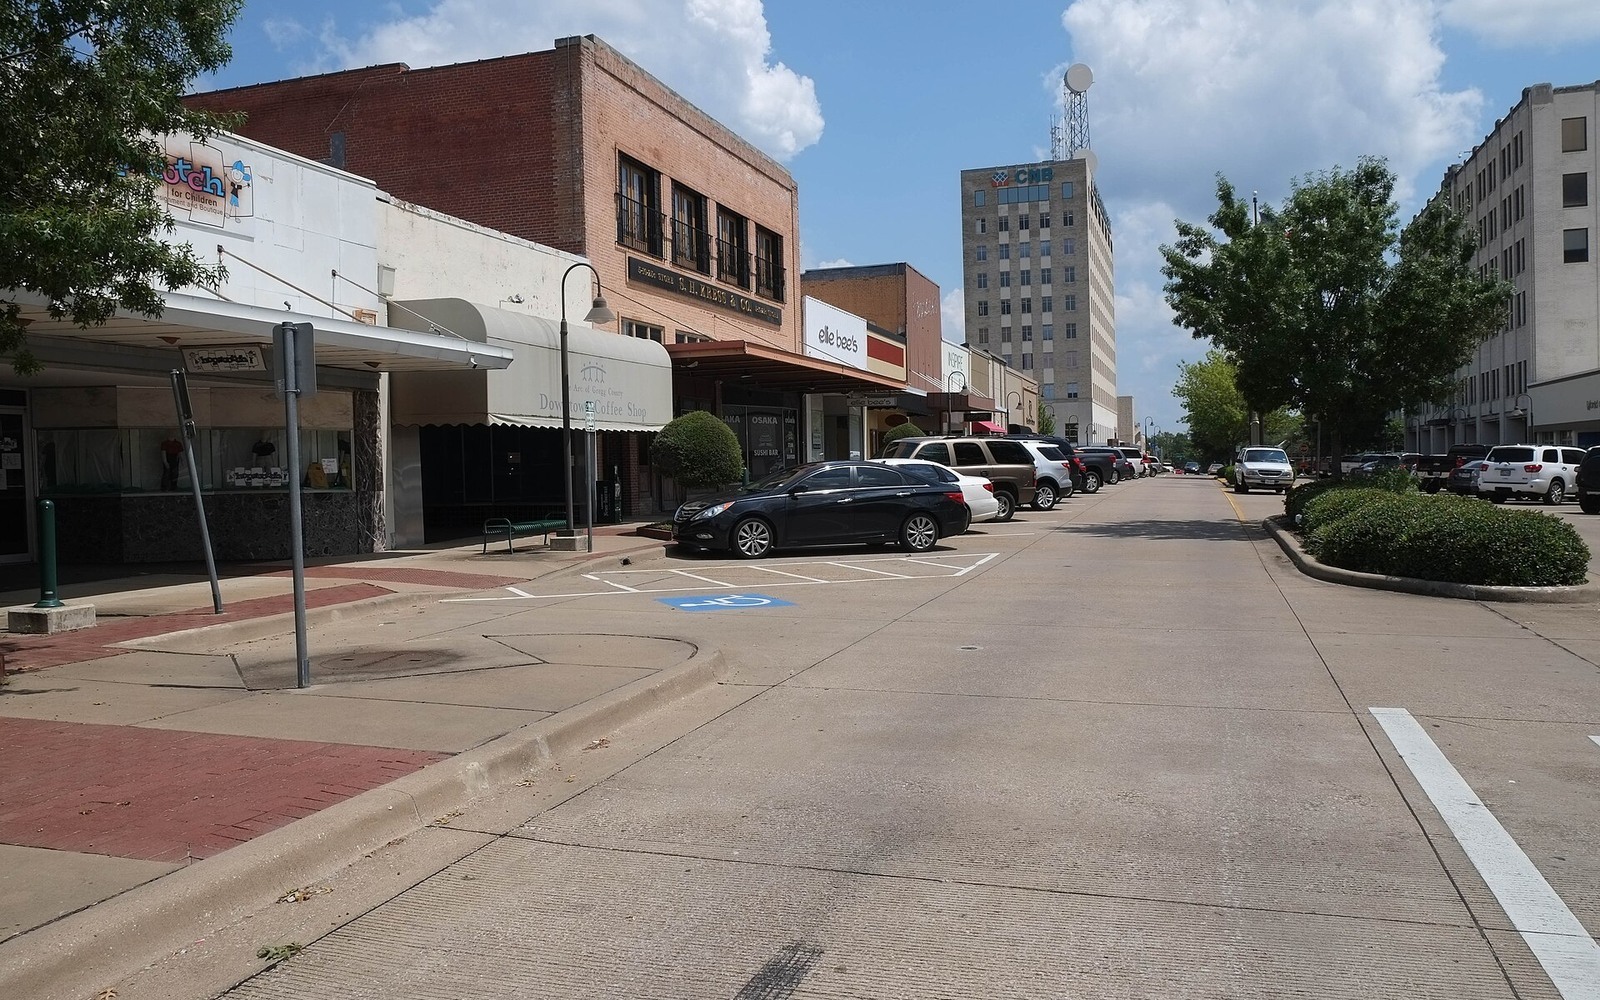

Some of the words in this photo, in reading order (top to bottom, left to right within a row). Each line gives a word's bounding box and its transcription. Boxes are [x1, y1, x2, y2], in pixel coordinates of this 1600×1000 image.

[1014, 167, 1054, 184] CNB
[171, 188, 183, 198] for
[185, 191, 218, 207] Children
[199, 203, 223, 216] Boutique
[679, 277, 687, 291] S.
[689, 280, 698, 294] H.
[700, 284, 727, 304] KRESS
[730, 294, 736, 307] &
[836, 329, 858, 353] bee's
[540, 393, 587, 413] Dowtow
[595, 399, 623, 416] Coffee
[627, 401, 647, 422] Shop
[722, 415, 741, 423] AKA
[751, 416, 778, 425] OSAKA
[753, 449, 768, 457] SUSHI
